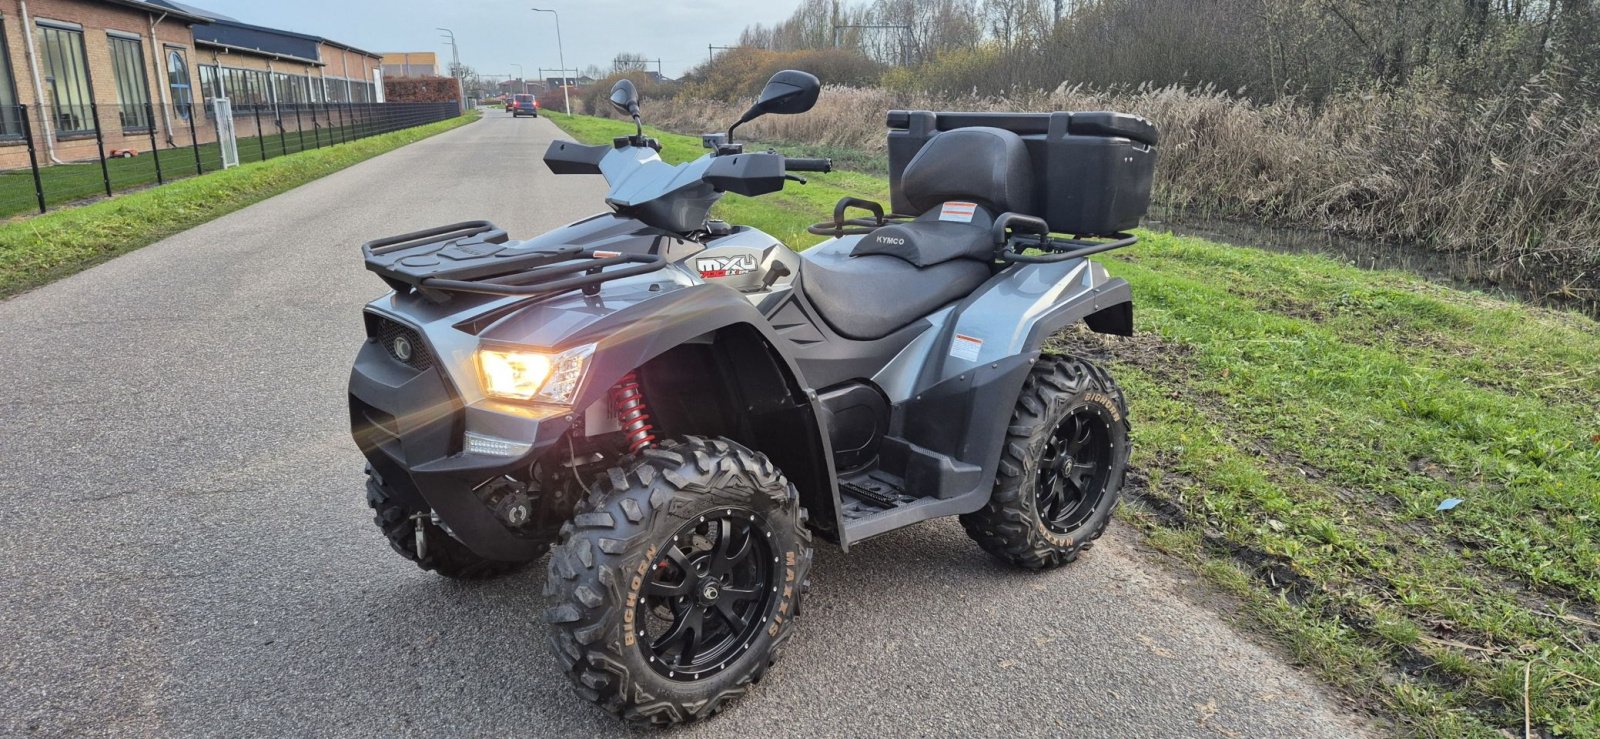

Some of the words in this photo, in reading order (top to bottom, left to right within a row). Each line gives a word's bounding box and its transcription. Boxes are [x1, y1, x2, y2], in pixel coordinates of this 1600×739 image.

[876, 235, 905, 245] KYMCO
[1084, 392, 1120, 422] BIGHORN
[624, 544, 656, 647] BIGHORN
[769, 551, 796, 637] MAXXIS
